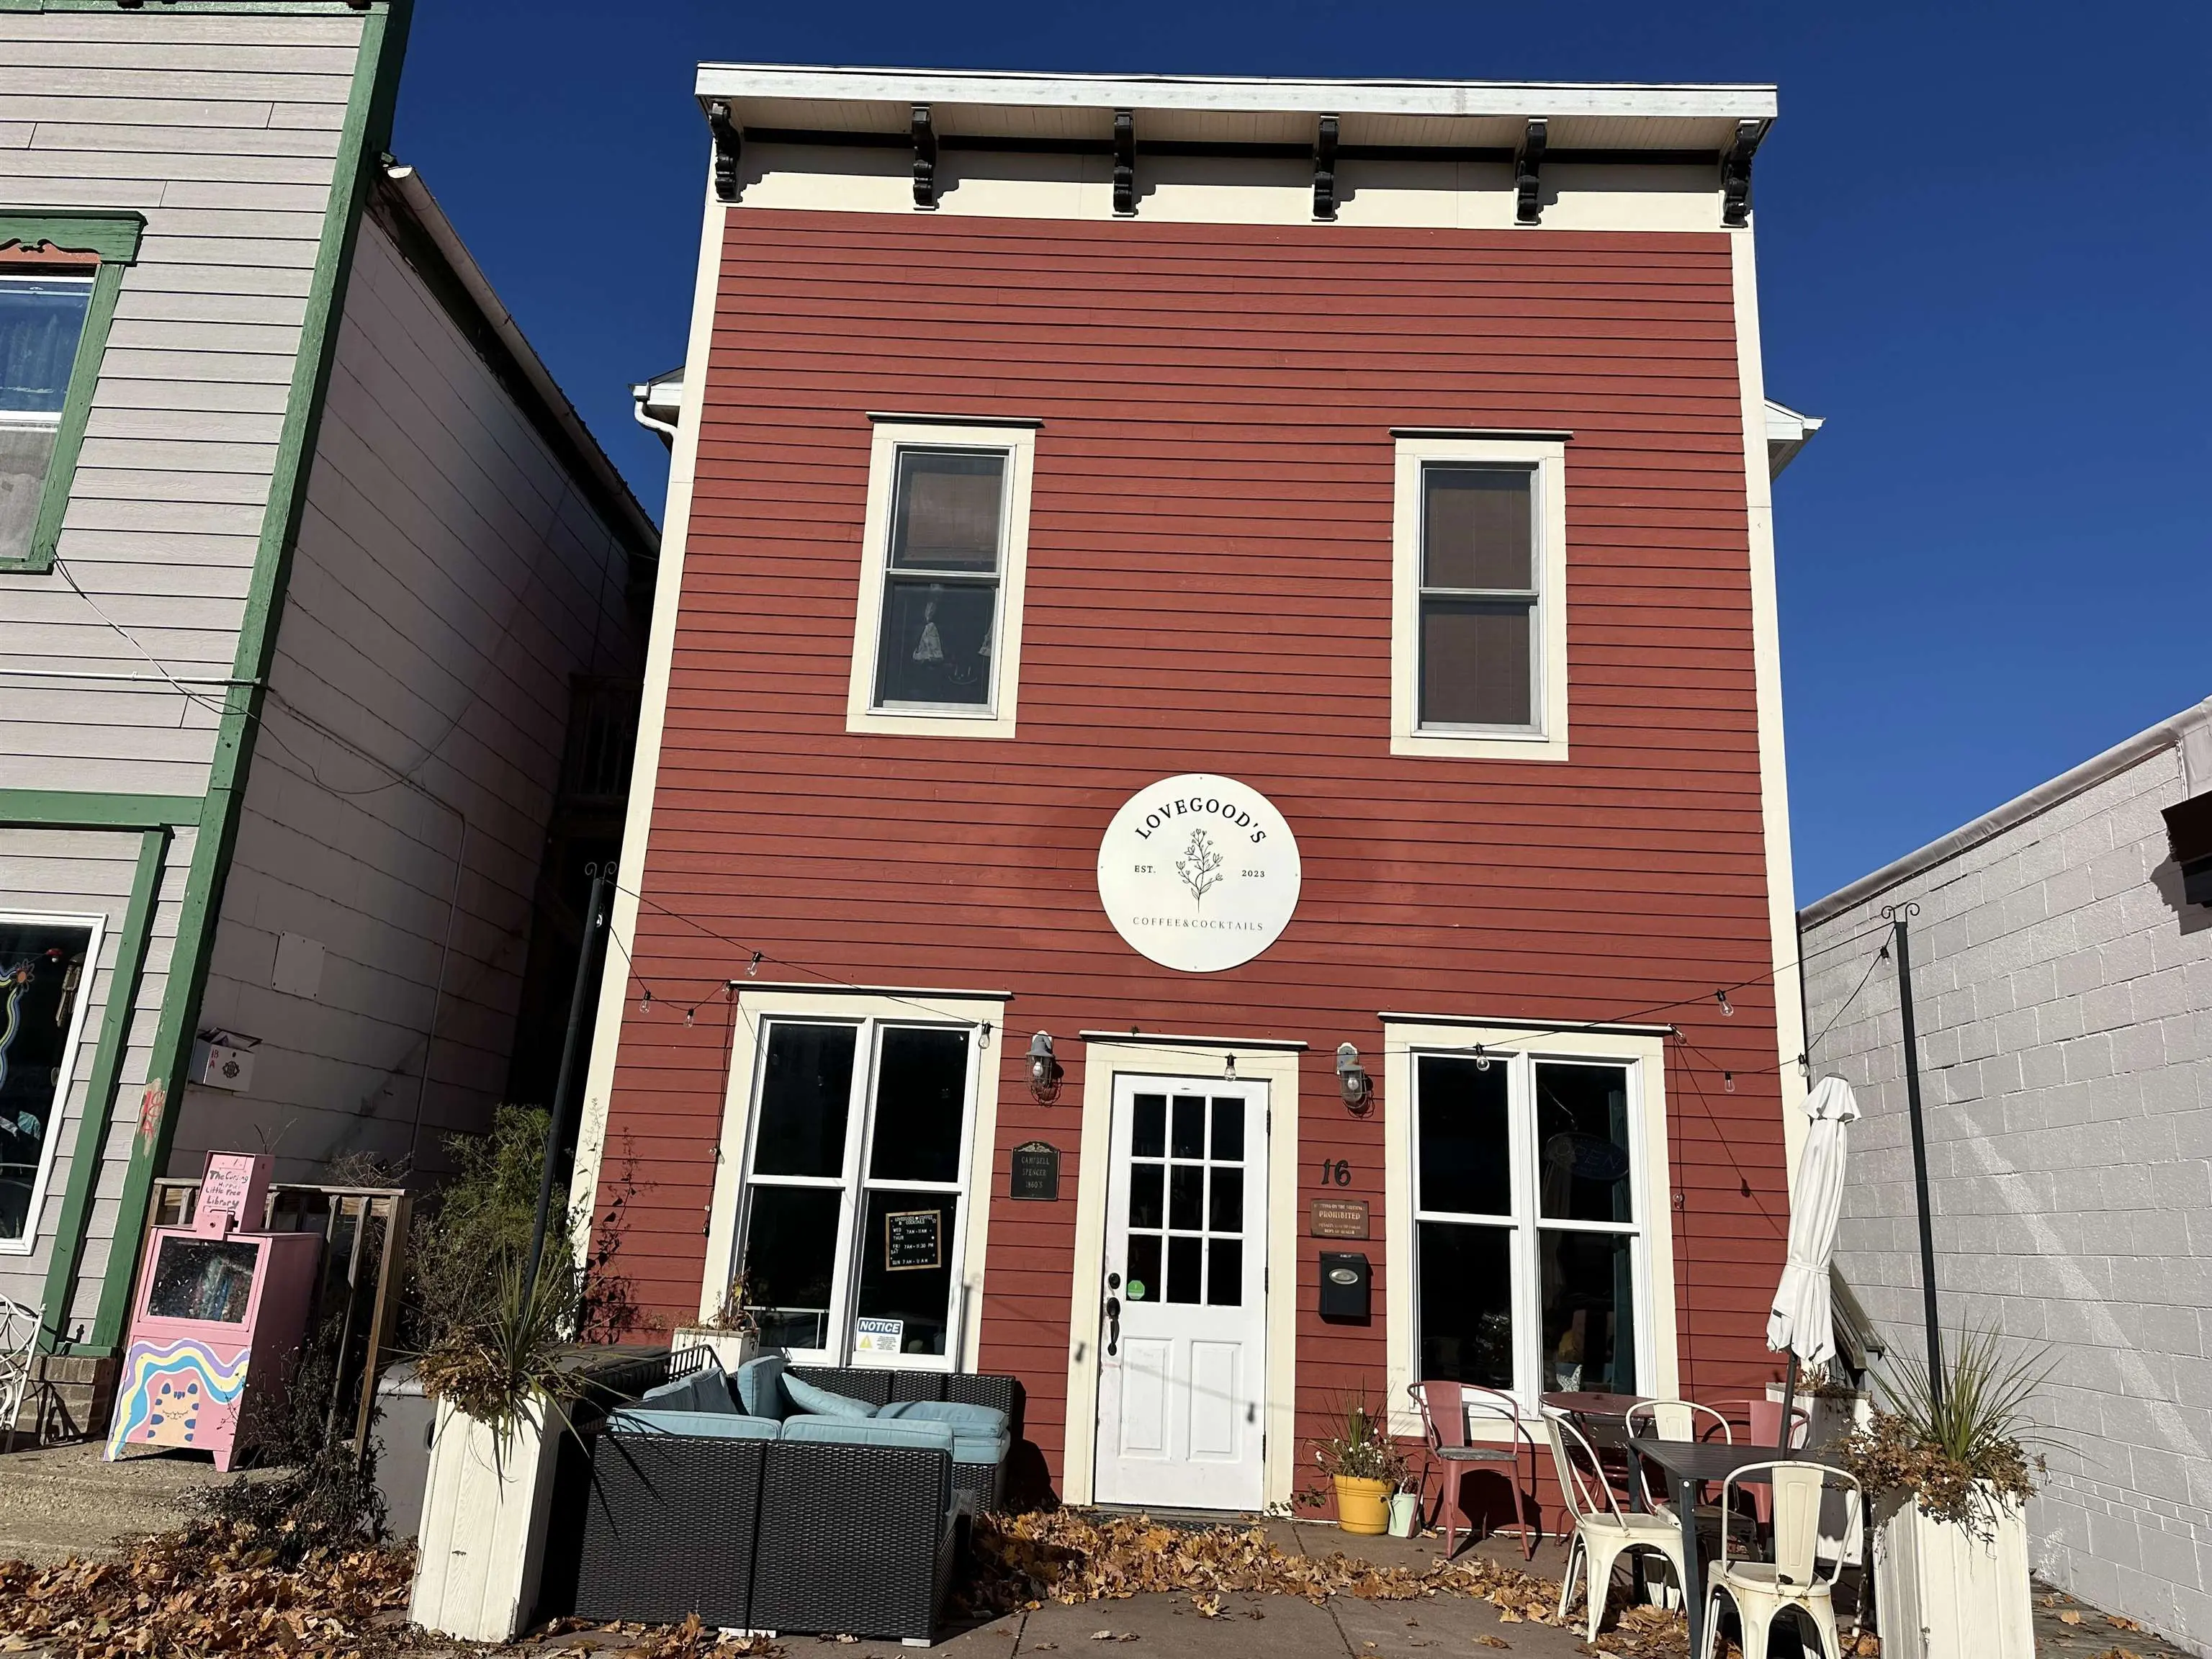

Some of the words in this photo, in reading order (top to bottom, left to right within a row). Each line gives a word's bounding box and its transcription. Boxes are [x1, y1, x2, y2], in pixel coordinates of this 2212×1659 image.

[1135, 797, 1267, 844] LOVEGOOD'S
[1134, 865, 1156, 873] EST.
[1241, 869, 1266, 878] 2023
[210, 1170, 225, 1180] The
[1321, 1159, 1352, 1187] 16
[207, 1195, 240, 1209] Library
[1318, 1210, 1361, 1220] PROHIBITED
[860, 1321, 901, 1333] NOTICE
